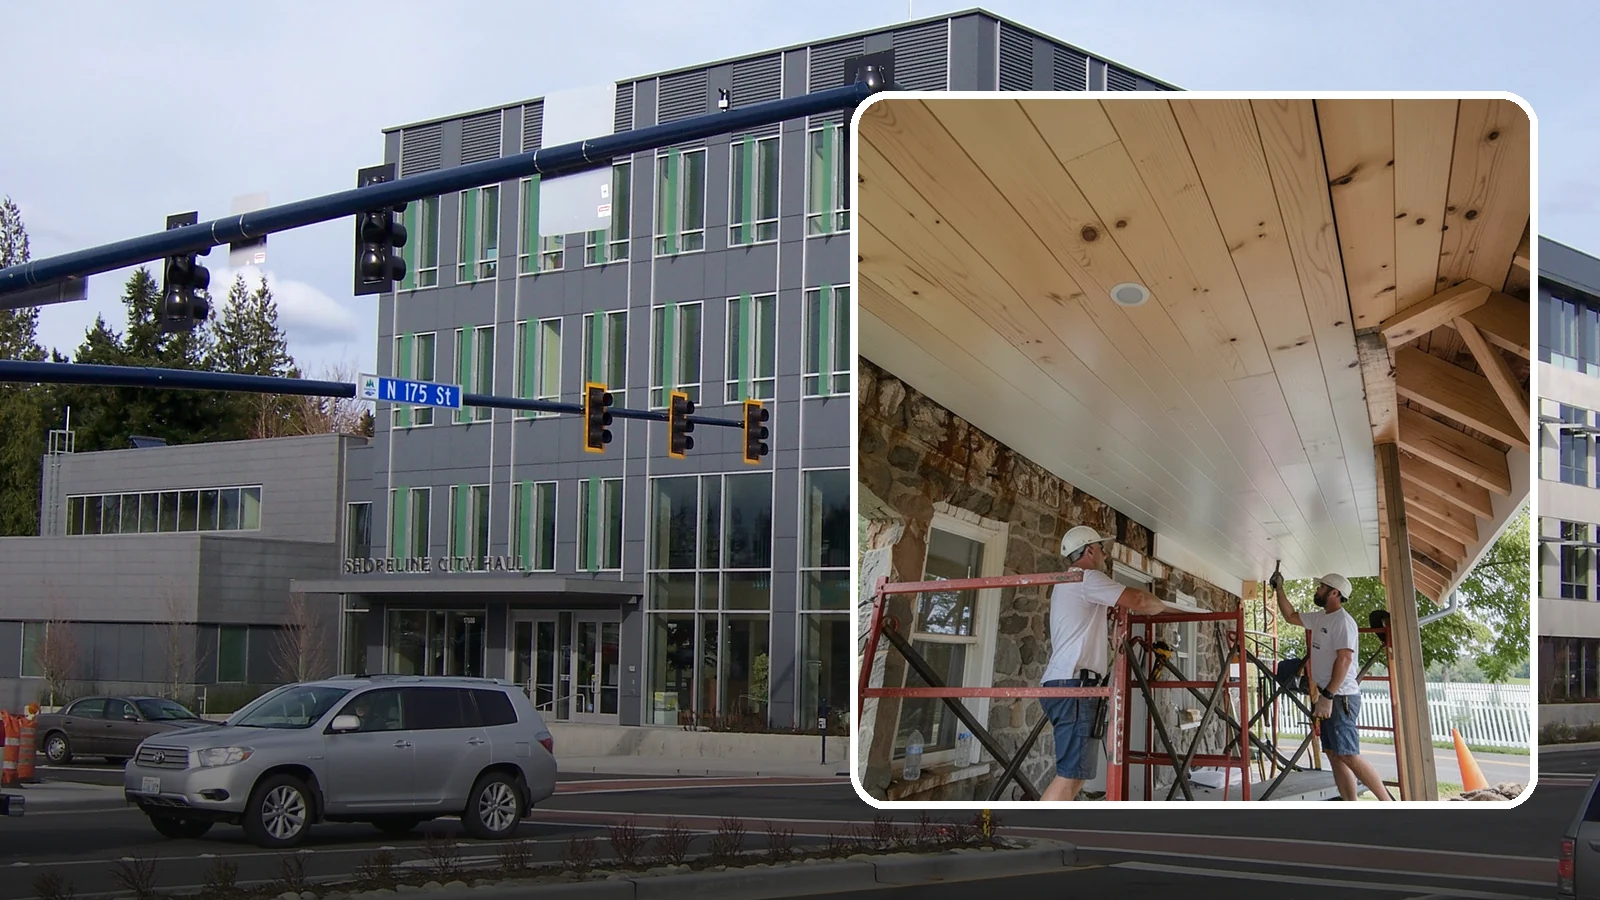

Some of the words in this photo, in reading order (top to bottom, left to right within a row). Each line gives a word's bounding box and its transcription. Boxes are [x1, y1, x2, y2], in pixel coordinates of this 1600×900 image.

[387, 380, 396, 400] N
[405, 382, 427, 403] 175
[436, 386, 451, 406] St
[344, 556, 432, 573] SHORELINE
[438, 556, 475, 572] CITY
[483, 556, 525, 571] HALL
